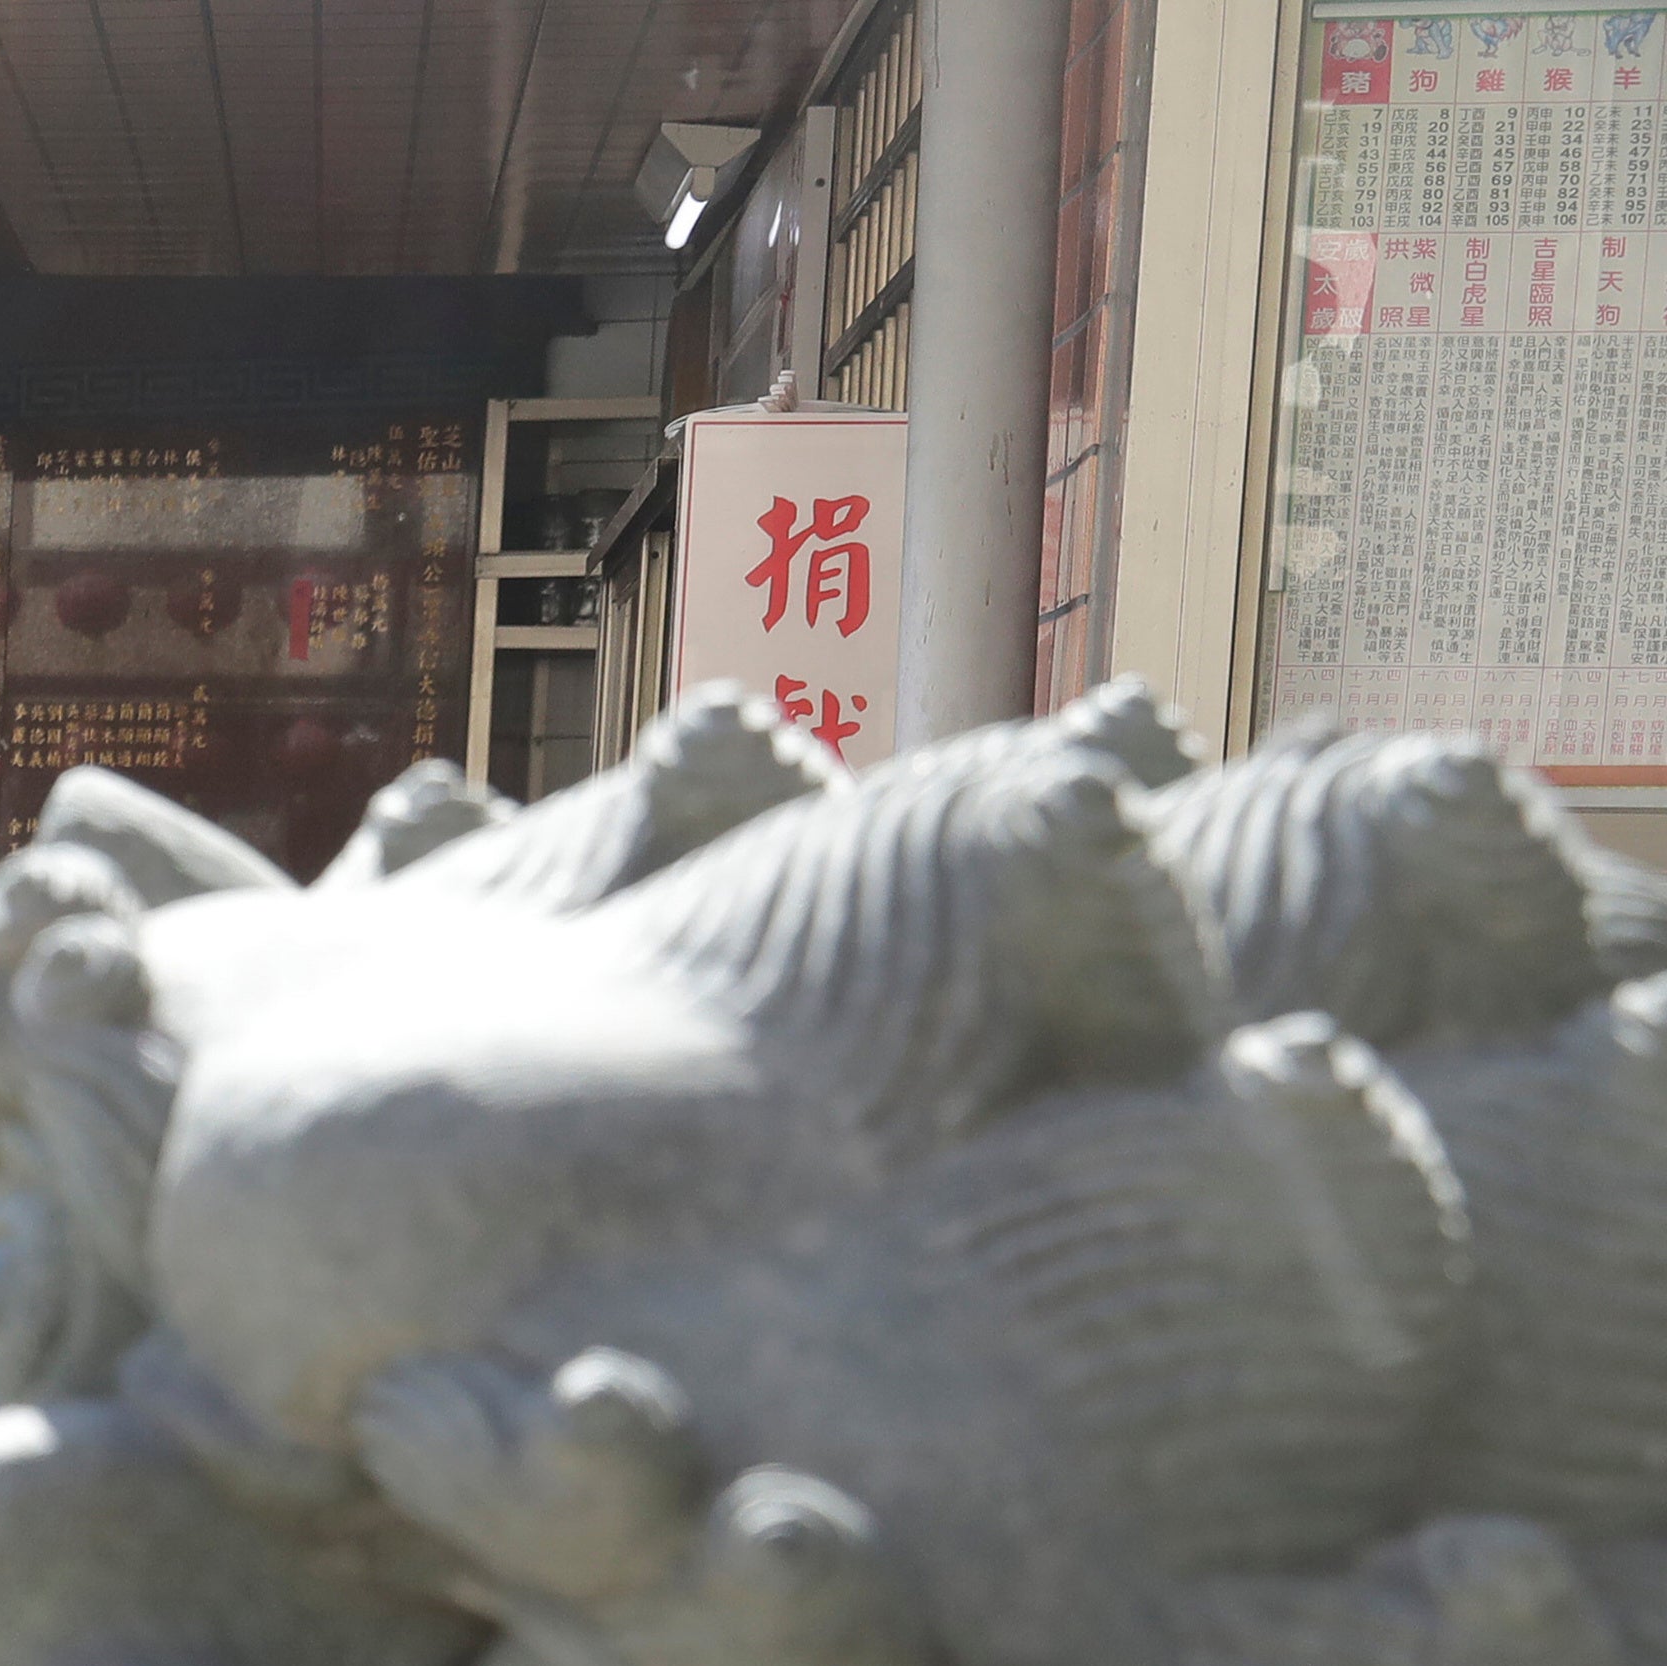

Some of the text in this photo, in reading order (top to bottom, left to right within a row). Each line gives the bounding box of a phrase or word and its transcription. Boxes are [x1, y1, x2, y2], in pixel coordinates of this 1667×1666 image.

[1341, 70, 1371, 94] 豬
[1409, 69, 1438, 92] 狗
[1475, 69, 1506, 92] 雞
[1543, 67, 1573, 91] 猴
[1613, 66, 1642, 90] 羊
[1374, 109, 1383, 120] 7
[1441, 109, 1449, 120] 8
[1508, 108, 1517, 119] 9
[1565, 107, 1585, 118] 10
[1633, 106, 1651, 117] 11
[1362, 122, 1382, 133] 19
[1429, 122, 1449, 133] 20
[1497, 121, 1515, 132] 21
[1565, 120, 1584, 132] 22
[1632, 119, 1651, 130] 23
[1361, 136, 1379, 146] 31
[1428, 135, 1448, 146] 32
[1496, 134, 1515, 146] 33
[1563, 134, 1583, 145] 34
[1631, 133, 1650, 144] 35
[1360, 149, 1380, 160] 43
[1427, 149, 1447, 160] 44
[1495, 148, 1514, 159] 45
[1563, 147, 1582, 159] 46
[1630, 146, 1650, 157] 47
[1359, 163, 1379, 173] 55
[1426, 162, 1446, 173] 56
[1494, 161, 1513, 172] 57
[1561, 161, 1581, 172] 58
[1629, 160, 1649, 171] 59
[1358, 176, 1377, 187] 67
[1425, 175, 1445, 186] 68
[1492, 174, 1512, 186] 69
[1561, 174, 1580, 185] 70
[1628, 173, 1646, 184] 71
[1357, 190, 1376, 200] 79
[1424, 189, 1444, 199] 80
[1491, 188, 1509, 199] 81
[1559, 187, 1579, 199] 82
[1627, 186, 1647, 198] 83
[1356, 203, 1374, 214] 91
[1423, 202, 1443, 213] 92
[1490, 201, 1510, 212] 93
[1559, 201, 1578, 212] 94
[1626, 200, 1646, 211] 95
[1351, 216, 1374, 227] 103
[1419, 215, 1442, 226] 104
[1486, 214, 1509, 226] 105
[1554, 214, 1577, 225] 106
[1622, 213, 1645, 225] 107
[1460, 237, 1490, 327] 制白虎星
[1527, 237, 1558, 327] 吉星臨照
[1596, 236, 1627, 326] 制天狗
